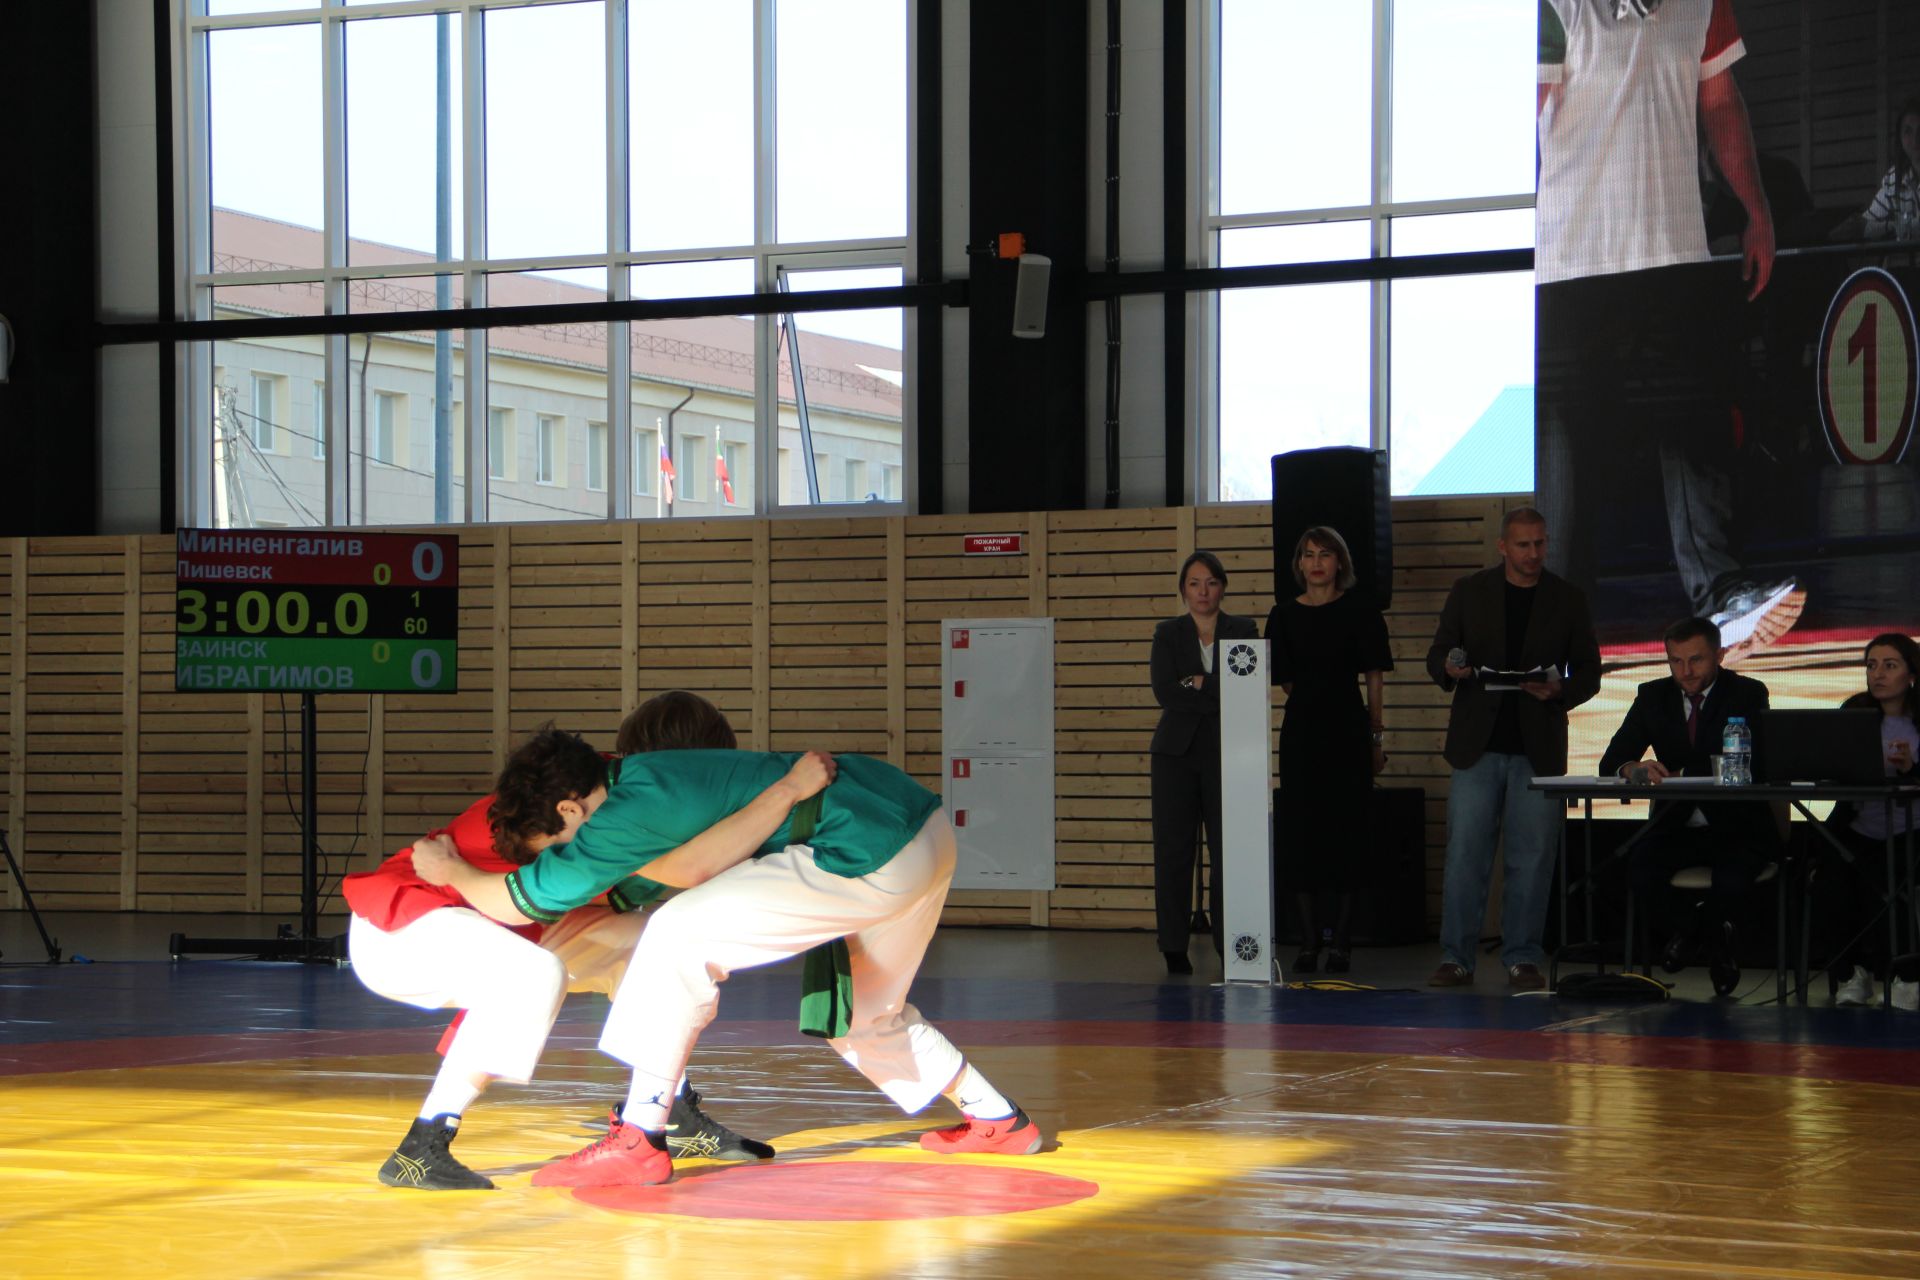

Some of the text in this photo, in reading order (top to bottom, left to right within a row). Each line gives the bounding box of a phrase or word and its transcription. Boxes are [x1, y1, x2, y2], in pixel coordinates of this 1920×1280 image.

[1847, 302, 1878, 444] 1
[177, 529, 363, 557] Минненгалив
[973, 537, 1011, 545] ПОЖАРНЫЙ
[177, 560, 273, 580] Пишевск
[411, 541, 444, 581] 0
[373, 563, 392, 586] 0
[410, 590, 421, 608] 1
[177, 588, 369, 635] 3:00.0
[403, 617, 428, 635] 60
[177, 639, 267, 659] ЗАИНСК
[371, 641, 391, 663] 0
[177, 664, 354, 689] ИБРАГИМОВ
[410, 648, 443, 688] 0
